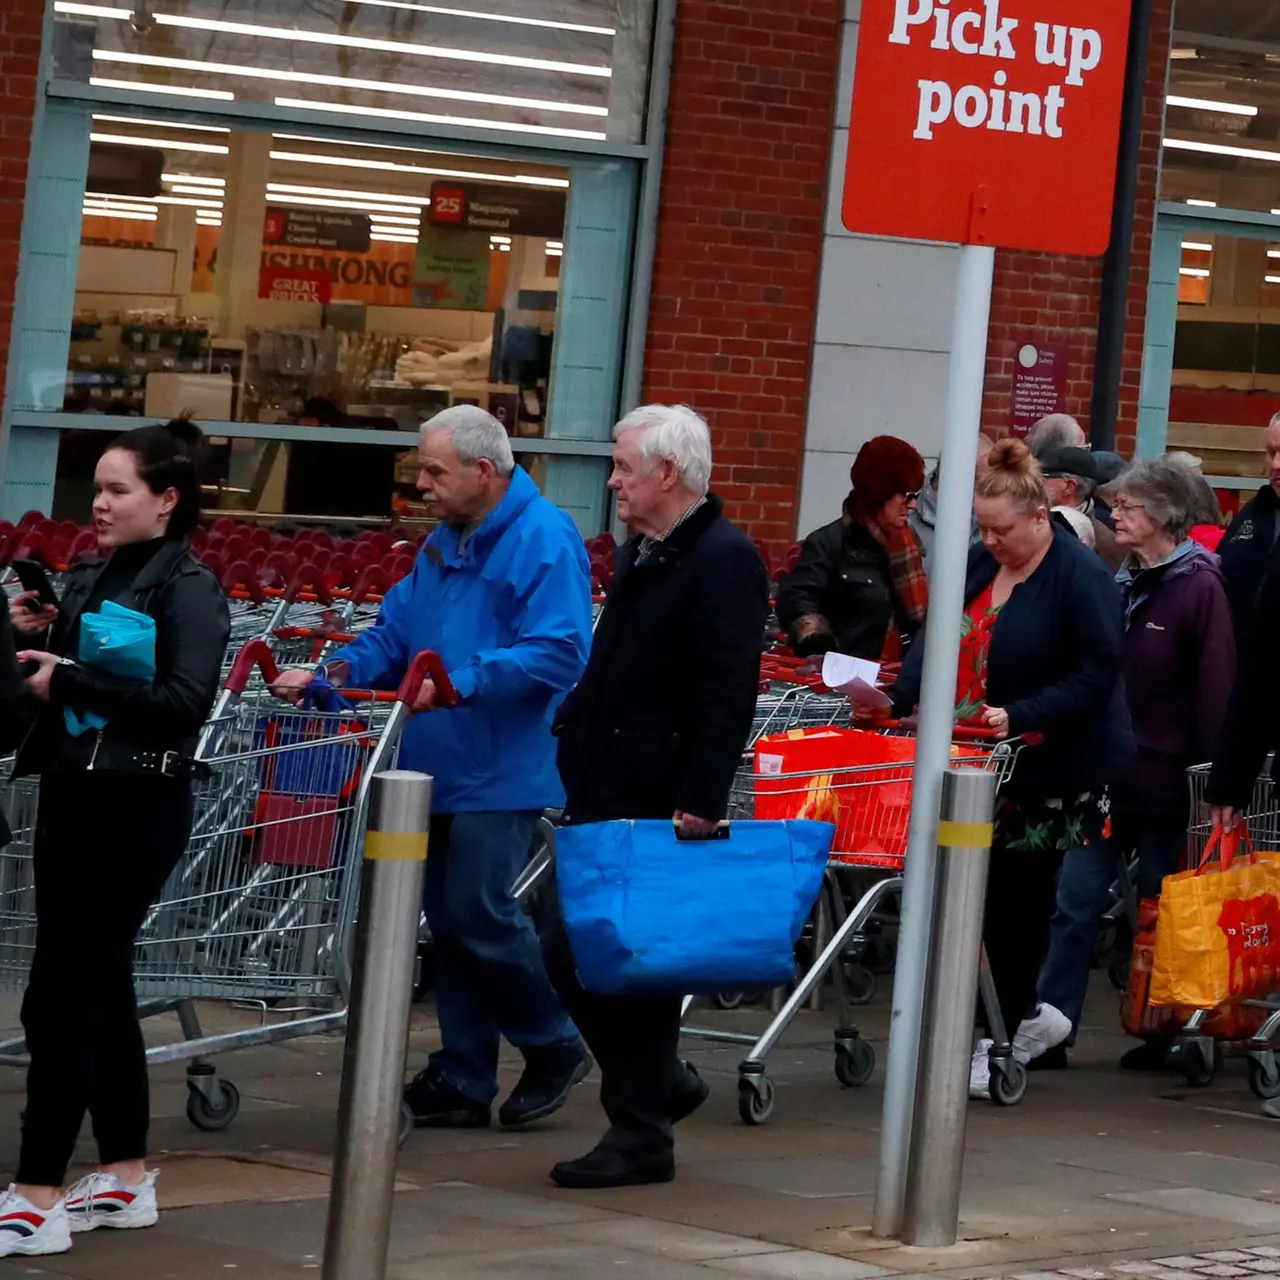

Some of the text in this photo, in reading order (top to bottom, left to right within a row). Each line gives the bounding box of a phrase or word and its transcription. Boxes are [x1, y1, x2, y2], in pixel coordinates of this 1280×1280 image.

[1033, 22, 1102, 87] up
[913, 70, 1065, 140] point
[435, 197, 460, 214] 25
[272, 277, 319, 293] GREAT
